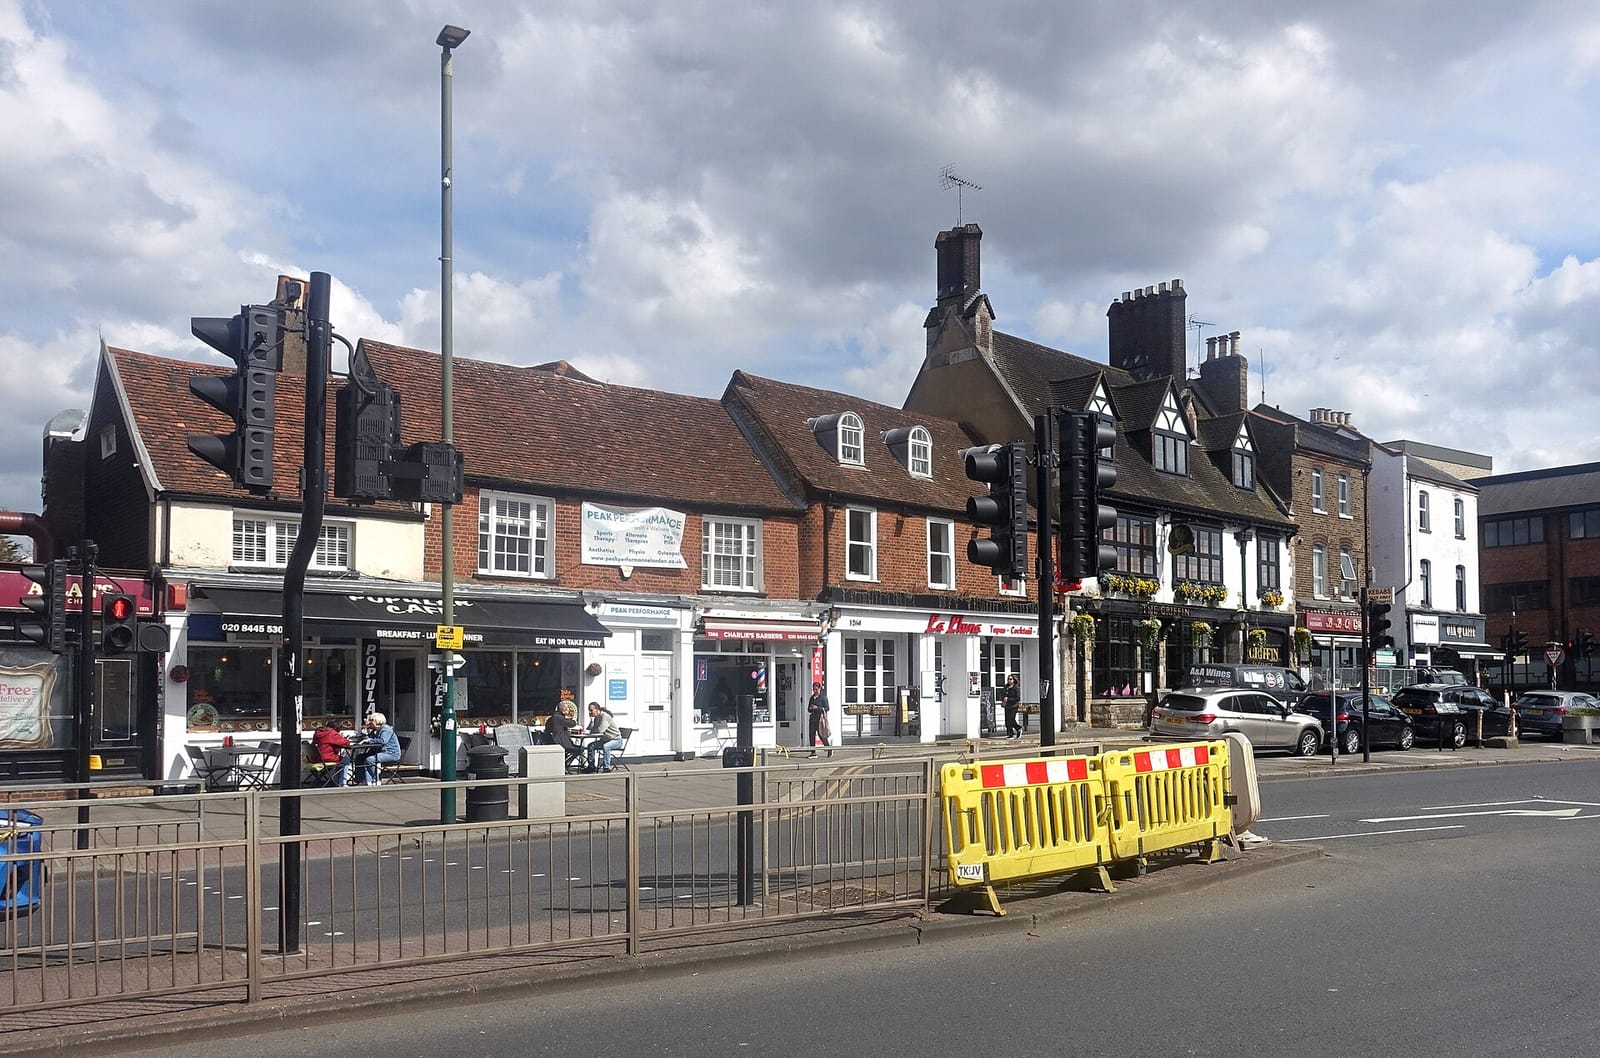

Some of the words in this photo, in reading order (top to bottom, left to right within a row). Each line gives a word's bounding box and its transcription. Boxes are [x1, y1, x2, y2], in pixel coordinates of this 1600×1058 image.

[587, 510, 612, 520] PEAK
[386, 604, 457, 617] CAF
[628, 608, 670, 616] PERFORMANCE
[1160, 606, 1190, 616] GRIFFIN
[222, 623, 239, 632] 020
[242, 624, 265, 633] 8445
[377, 629, 421, 640] BREAKFAST
[723, 631, 755, 639] CHARLIE'S
[756, 632, 783, 640] BARBERS
[1190, 667, 1205, 676] A&A
[1206, 668, 1232, 679] Wines
